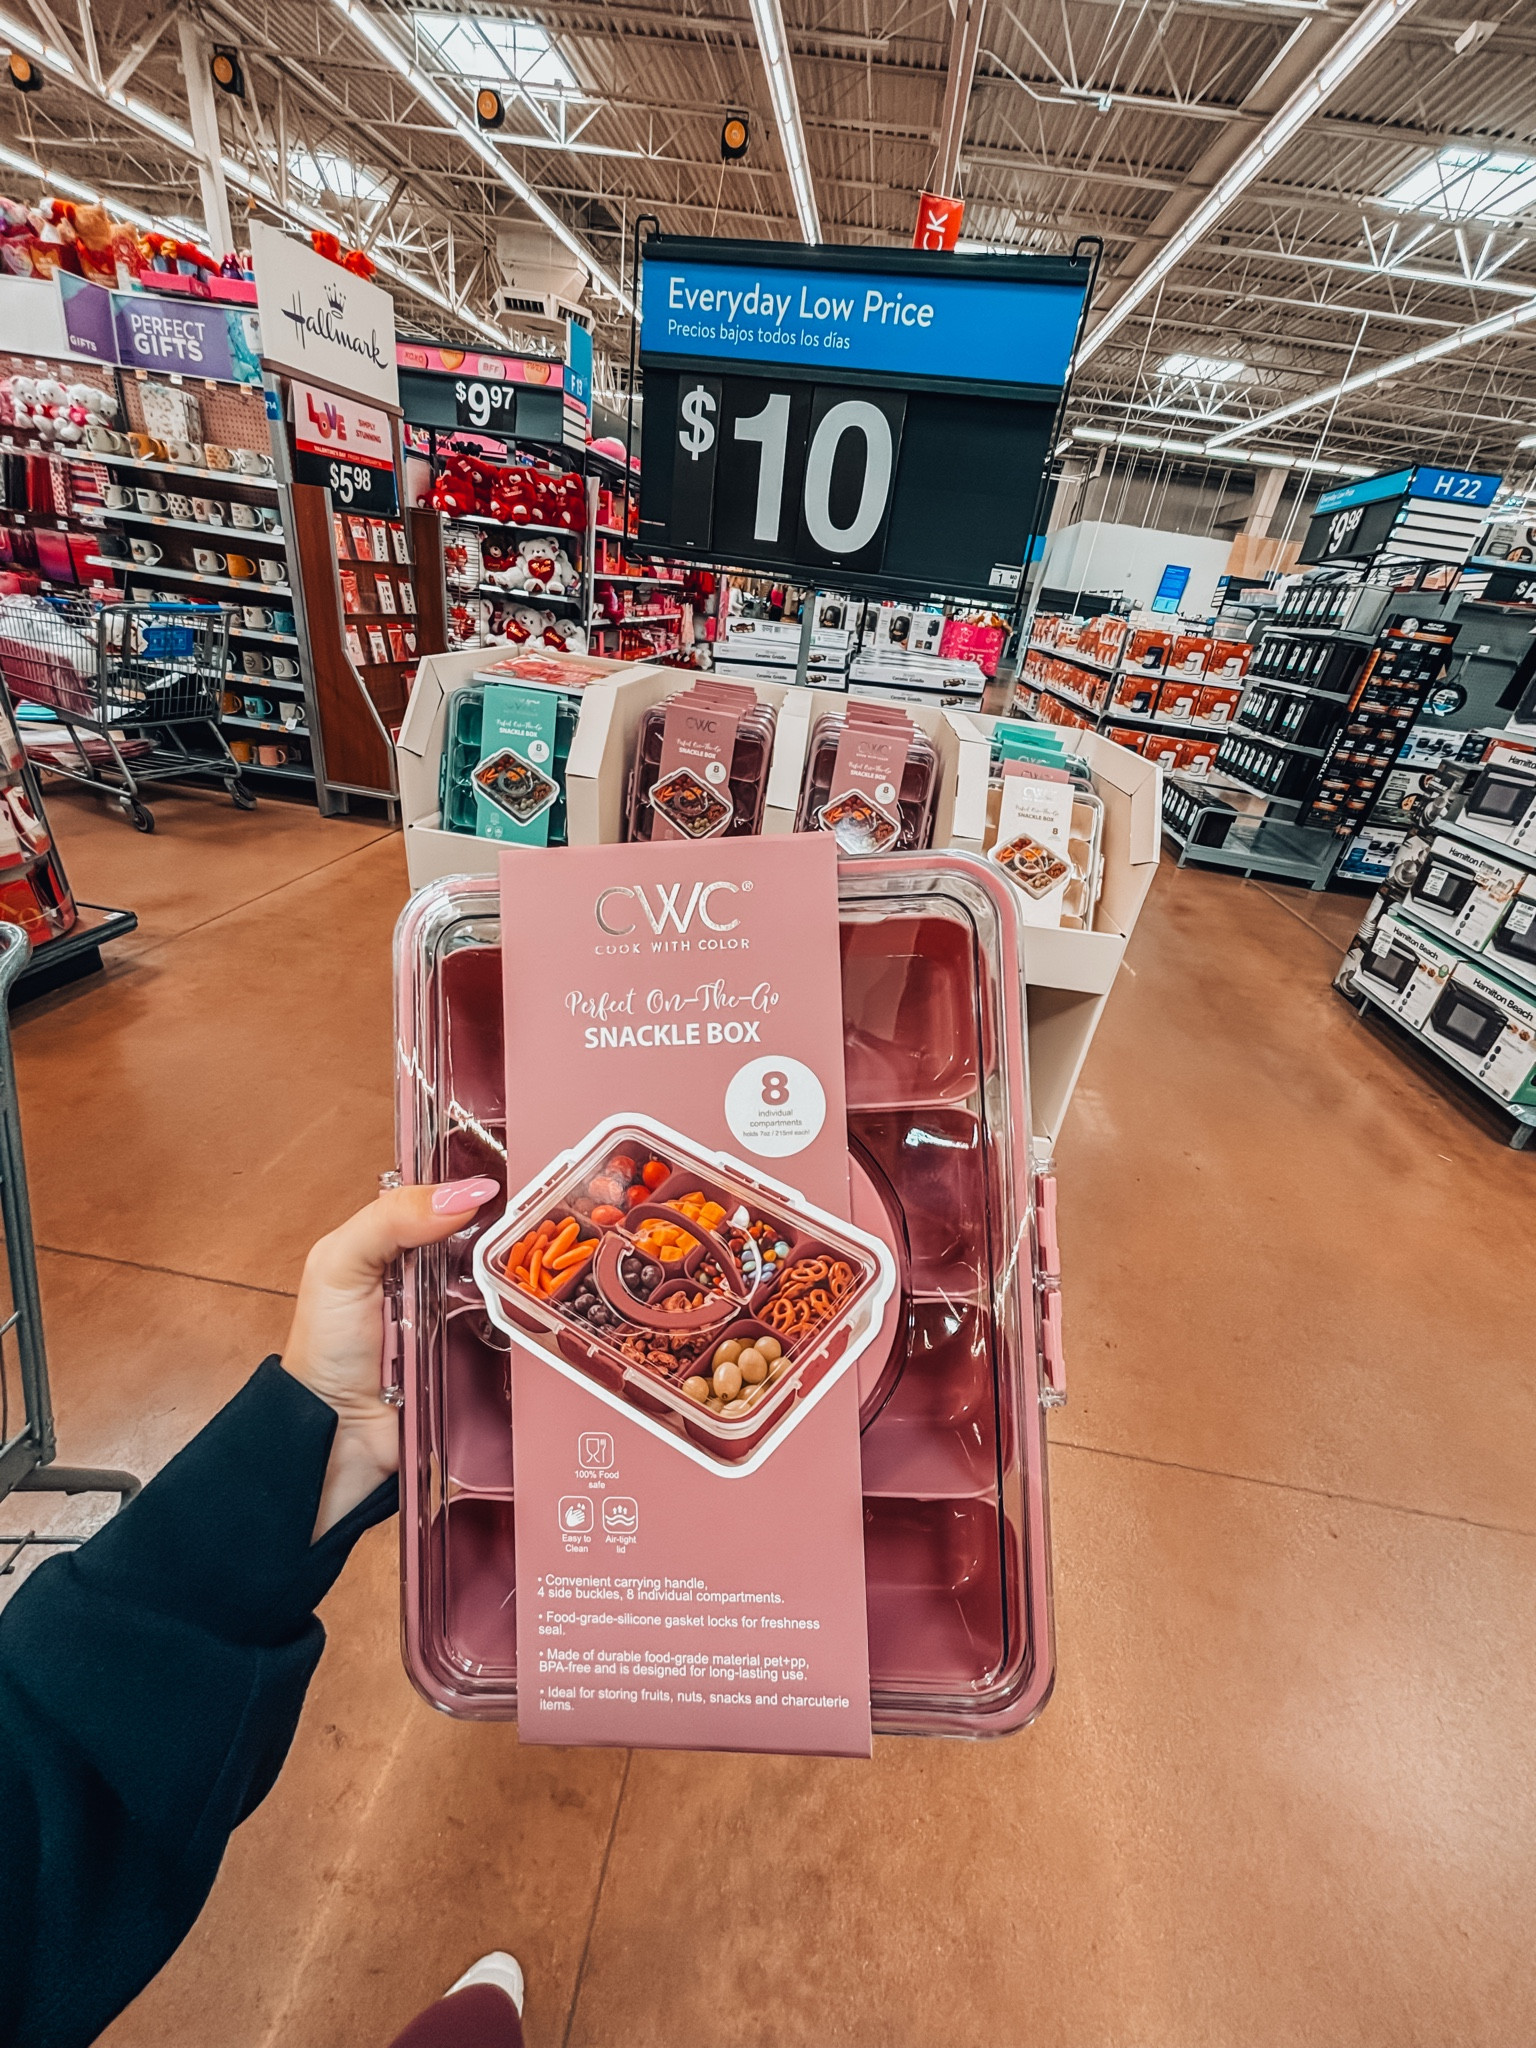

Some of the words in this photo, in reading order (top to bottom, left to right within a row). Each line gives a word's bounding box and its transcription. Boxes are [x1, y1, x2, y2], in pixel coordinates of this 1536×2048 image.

[668, 277, 792, 326] Everyday
[799, 285, 854, 322] Low
[863, 289, 934, 328] Price
[131, 313, 205, 342] PERFECT
[281, 290, 389, 371] Hallmark
[668, 319, 716, 339] Precios
[720, 322, 754, 344] bajos
[757, 325, 796, 346] todos
[800, 329, 820, 348] los
[824, 331, 850, 350] días
[69, 335, 97, 352] GIFTS
[134, 333, 203, 362] GIFTS
[404, 351, 423, 363] XOXO
[483, 362, 500, 374] BFF
[571, 374, 576, 391] F
[576, 379, 583, 396] 13
[306, 392, 347, 441] LOVE
[358, 418, 375, 431] SIMPLY
[356, 429, 381, 443] STUNNING
[1433, 475, 1451, 496] H
[1452, 478, 1482, 500] 22
[963, 653, 985, 666] $25
[499, 727, 525, 736] SNACKLE
[686, 716, 718, 733] CWC
[536, 743, 542, 752] 8
[679, 746, 704, 757] SNACKLE
[704, 751, 717, 759] BOX
[1317, 728, 1344, 782] DURACELL
[713, 765, 719, 773] 8
[850, 770, 874, 779] SNACKLE
[883, 786, 889, 794] 8
[1017, 812, 1042, 821] SNACKLE
[1043, 815, 1054, 823] BOX
[1449, 846, 1479, 867] Hamilton
[595, 943, 641, 955] COOK
[651, 940, 691, 953] WITH
[698, 938, 750, 951] COLOR
[1393, 926, 1419, 949] Hamilton
[1419, 942, 1439, 960] Beach
[565, 987, 637, 1021] Perfect
[646, 978, 780, 1014] On-The-Go
[1473, 977, 1507, 1005] Hamilton
[1507, 999, 1534, 1022] Beach
[584, 1023, 701, 1049] SNACKLE
[707, 1021, 761, 1044] BOX
[761, 1070, 790, 1106] 8
[758, 1109, 793, 1118] individual
[750, 1119, 802, 1129] compartments
[775, 1129, 793, 1137] 215ml
[575, 1470, 597, 1479] 100%
[599, 1470, 620, 1479] Food
[589, 1480, 606, 1489] safe
[562, 1534, 582, 1544] Easy
[583, 1534, 592, 1543] to
[605, 1535, 637, 1546] Air-tight
[565, 1544, 589, 1553] Clean
[616, 1546, 626, 1554] lid
[545, 1574, 611, 1587] Convenient
[614, 1576, 661, 1591] carrying
[664, 1577, 708, 1590] handle,
[537, 1586, 545, 1598] 4
[548, 1587, 572, 1598] side
[575, 1588, 623, 1600] buckles,
[626, 1589, 634, 1600] 8
[637, 1589, 693, 1601] individual
[696, 1592, 785, 1605] compartments.
[546, 1611, 661, 1626] Food-grade-silicone
[664, 1614, 704, 1629] gasket
[707, 1615, 738, 1627] locks
[741, 1616, 758, 1628] for
[761, 1616, 820, 1630] freshness
[538, 1624, 566, 1636] seal.
[547, 1648, 580, 1661] Made
[583, 1649, 595, 1661] of
[597, 1650, 641, 1662] durable
[644, 1651, 709, 1667] food-grade
[712, 1653, 760, 1666] material
[763, 1655, 809, 1670] pet+pp,
[539, 1660, 591, 1673] BPA-free
[594, 1662, 616, 1674] and
[620, 1663, 629, 1675] is
[632, 1664, 686, 1678] designed
[690, 1665, 706, 1677] for
[709, 1665, 778, 1682] long-lasting
[781, 1669, 807, 1681] use.
[539, 1698, 575, 1711] items.
[548, 1686, 576, 1698] Ideal
[579, 1686, 595, 1699] for
[598, 1688, 638, 1703] storing
[641, 1688, 674, 1703] fruits,
[677, 1691, 706, 1704] nuts,
[709, 1692, 752, 1705] snacks
[755, 1693, 778, 1705] and
[781, 1693, 850, 1708] charcuterie
